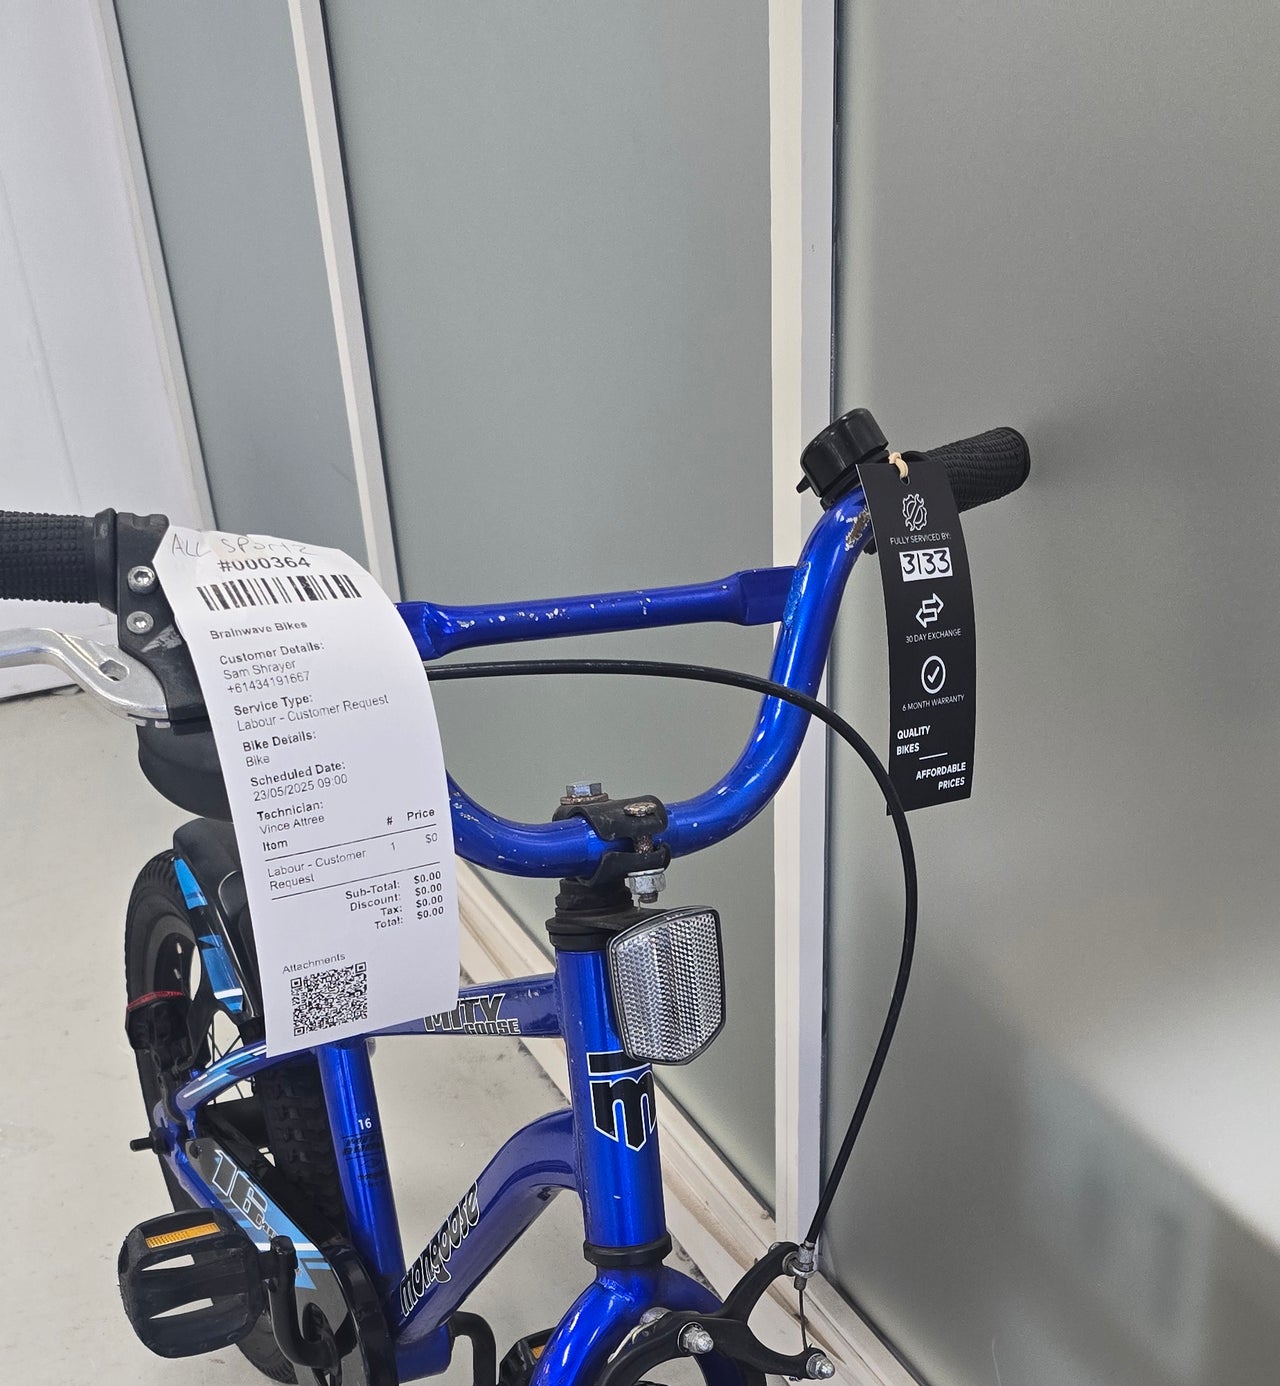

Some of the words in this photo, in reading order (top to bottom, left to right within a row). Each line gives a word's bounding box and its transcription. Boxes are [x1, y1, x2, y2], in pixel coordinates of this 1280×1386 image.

[171, 533, 212, 557] ALL
[890, 536, 909, 545] FULLY
[910, 533, 940, 543] SERVICED
[941, 532, 952, 540] BY:
[217, 556, 311, 572] #000364
[902, 550, 950, 575] 3133
[210, 625, 272, 640] Brainwave
[275, 620, 308, 632] Bikes
[906, 635, 914, 644] 30
[914, 633, 927, 642] DAY
[928, 628, 962, 640] EXCHANGE
[219, 648, 277, 666] Customer
[280, 642, 325, 655] Details:
[223, 667, 250, 680] Sam
[252, 658, 297, 677] Shrayer
[227, 671, 311, 694] +61434191667
[234, 700, 278, 716] Service
[281, 694, 313, 711] Type:
[238, 716, 276, 732] Labour
[287, 704, 340, 723] Customer
[343, 694, 389, 713] Request
[902, 704, 906, 712] 6
[908, 700, 930, 710] MONTH
[932, 694, 964, 706] WARRANTY
[242, 740, 269, 752] Bike
[272, 730, 316, 747] Details:
[897, 725, 930, 740] QUALITY
[896, 742, 920, 756] BIKES
[246, 754, 270, 768] Bike
[916, 762, 966, 780] AFFORDABLE
[250, 766, 312, 787] Scheduled
[315, 761, 346, 775] Date:
[938, 776, 965, 790] PRICES
[253, 780, 315, 802] 23/05/2025
[317, 773, 348, 788] 09:00
[256, 800, 324, 822] Technician:
[259, 820, 290, 835] Vince
[293, 814, 325, 829] Attree
[262, 838, 288, 852] Item
[386, 816, 393, 826] #
[406, 808, 435, 822] Price
[267, 864, 305, 878] Labour
[315, 849, 366, 868] Customer
[391, 842, 396, 850] 1
[425, 832, 438, 844] $0
[270, 873, 315, 891] Request
[345, 880, 400, 900] Sub-Total:
[414, 870, 441, 884] $0.00
[350, 893, 401, 912] Discount:
[414, 882, 442, 896] $0.00
[380, 904, 402, 917] Tax:
[416, 894, 443, 908] $0.00
[374, 916, 403, 930] Total:
[416, 906, 444, 920] $0.00
[282, 952, 346, 974] Attachments
[464, 1018, 521, 1036] GOOSE
[358, 1118, 372, 1130] 16
[401, 1180, 480, 1318] mongoose
